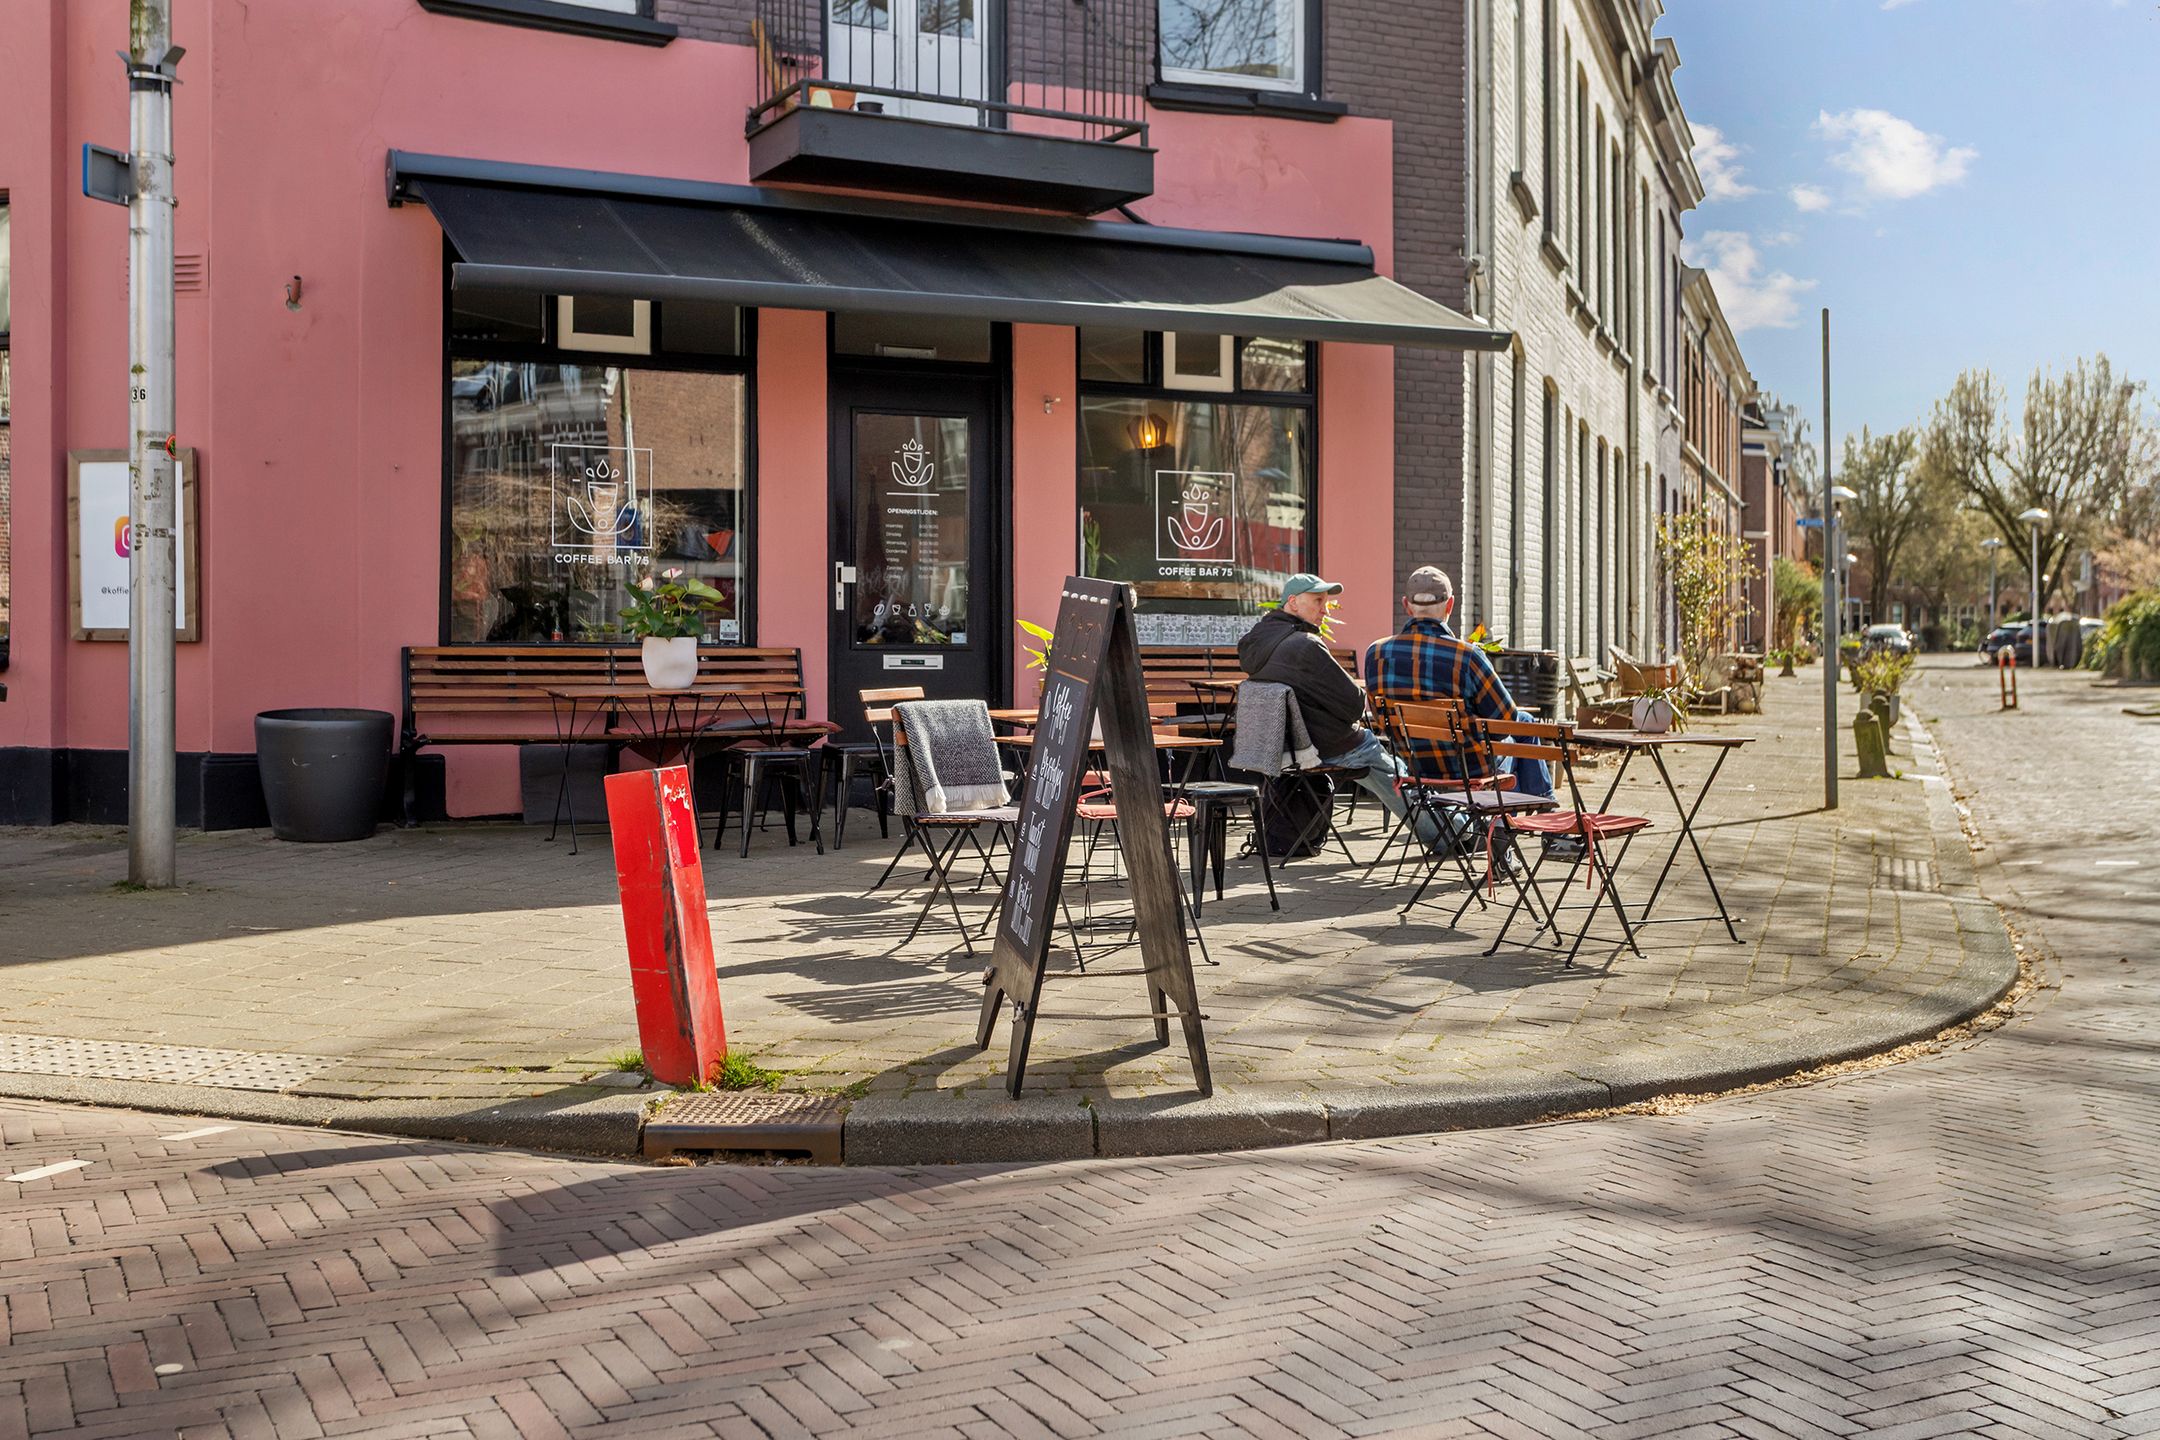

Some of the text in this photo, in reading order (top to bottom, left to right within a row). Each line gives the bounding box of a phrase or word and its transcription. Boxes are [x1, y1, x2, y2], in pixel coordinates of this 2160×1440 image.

[132, 388, 146, 400] 36
[554, 553, 650, 566] COFFEE BAR 75
[1158, 566, 1233, 577] COFFEE BAR 75
[101, 586, 129, 595] @koffie
